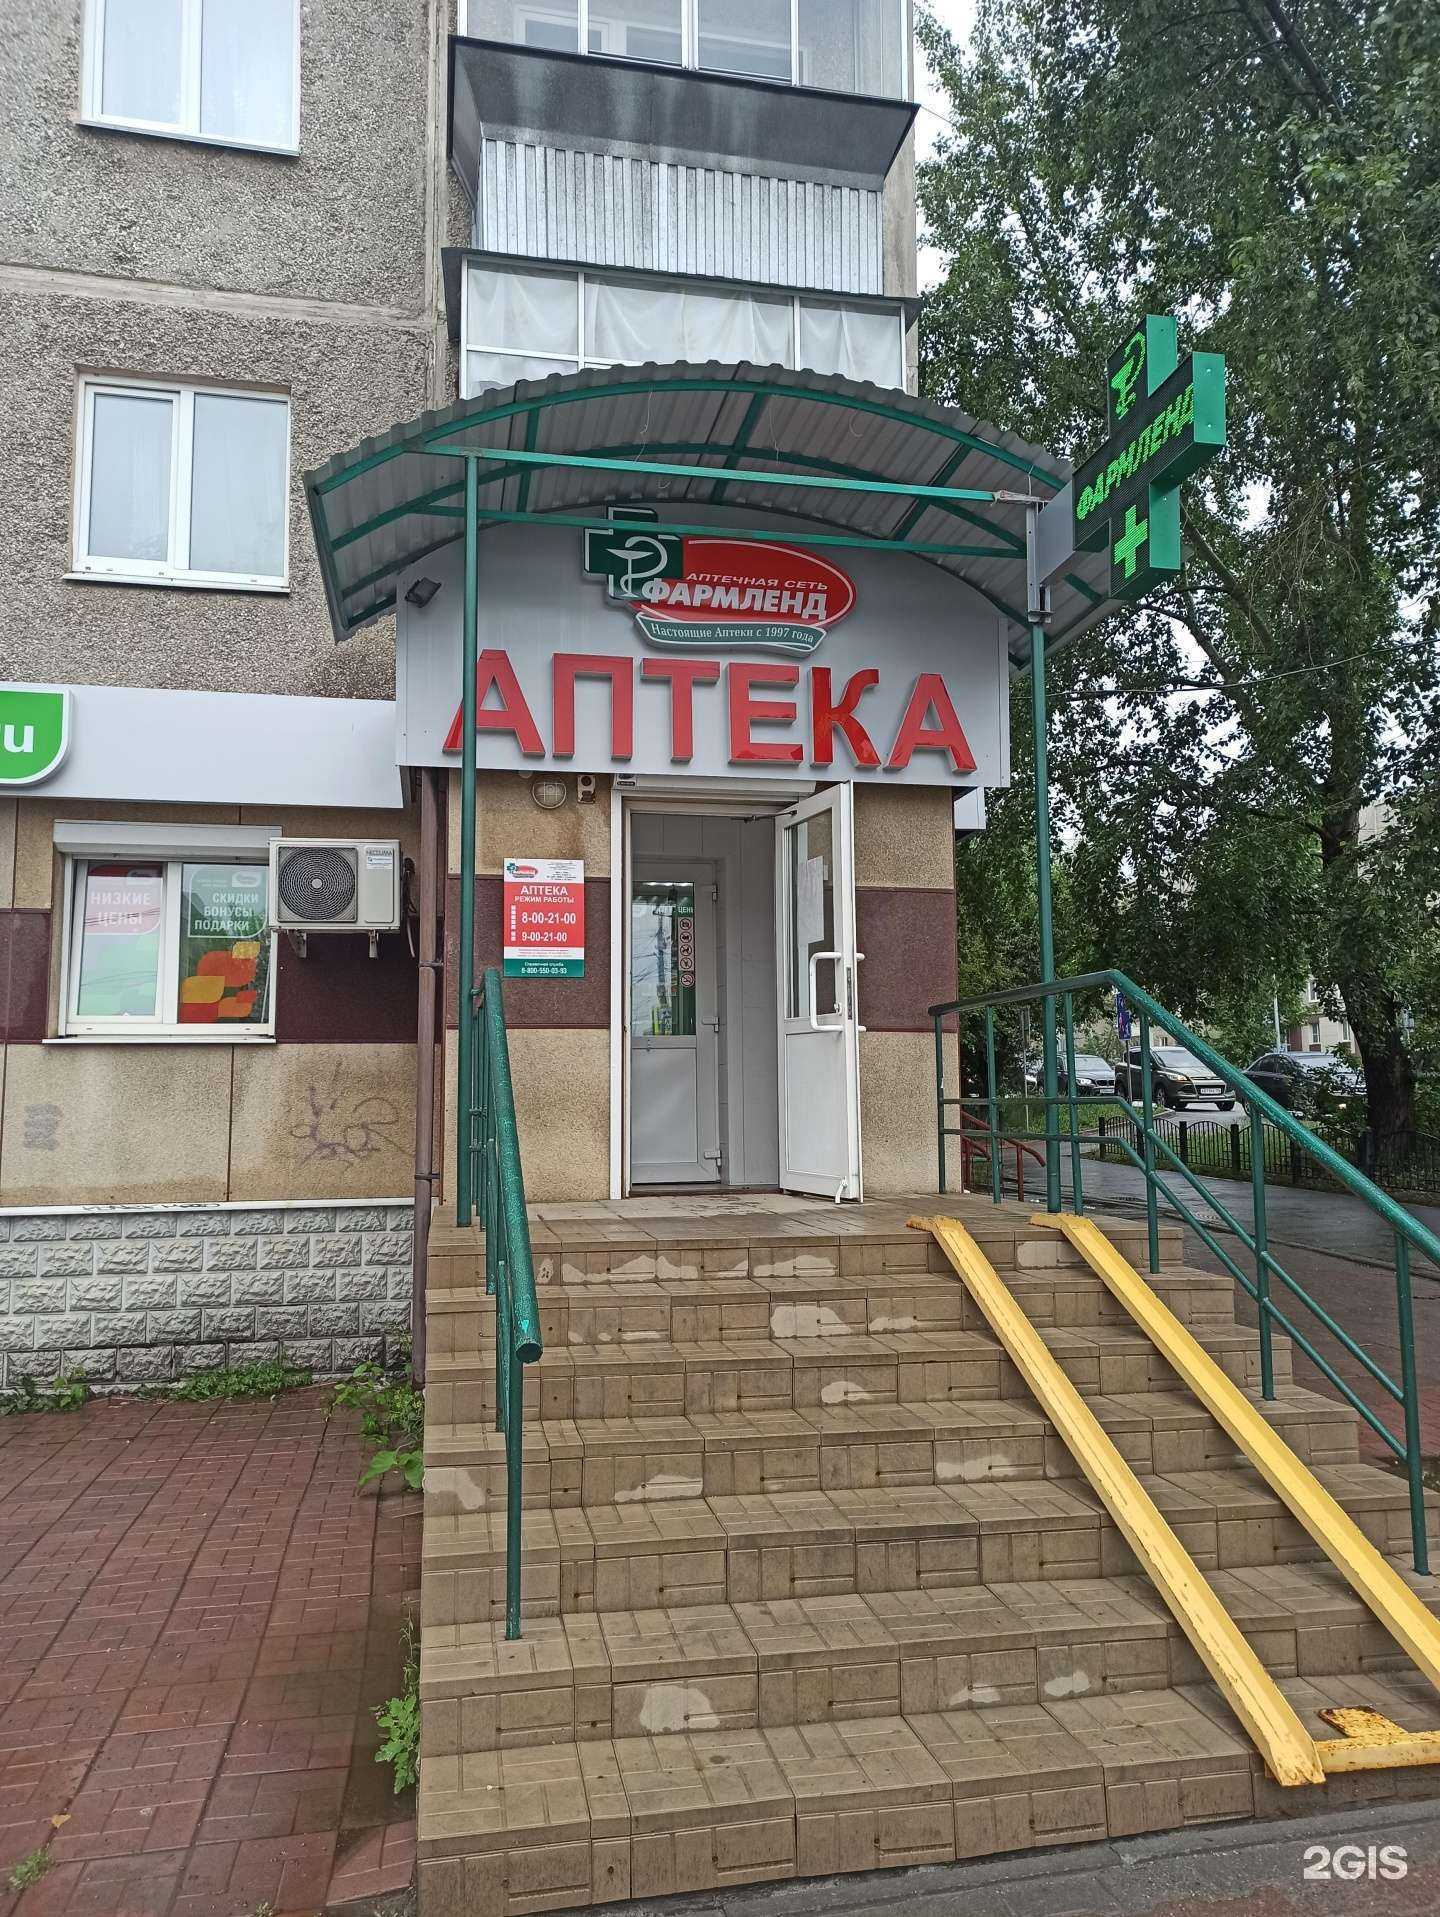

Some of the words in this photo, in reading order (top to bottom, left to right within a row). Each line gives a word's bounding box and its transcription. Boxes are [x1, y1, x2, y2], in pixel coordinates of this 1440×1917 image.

[686, 572, 778, 588] АПТЕЧНАЯ
[784, 580, 828, 591] СЕТЬ
[641, 578, 827, 620] ФАРМЛЕНД
[650, 622, 712, 639] Настоящие
[714, 626, 753, 638] Аптеки
[756, 629, 762, 638] с
[766, 626, 790, 639] 1997
[791, 630, 815, 643] года
[442, 648, 978, 774] АПТЕКА
[520, 885, 568, 896] АПТЕКА
[91, 891, 151, 906] НИЗКИЕ
[212, 892, 259, 905] СКИДКИ
[514, 895, 542, 903] РЕЖИМ
[543, 896, 575, 904] РАБОТЫ
[204, 906, 252, 918] БОНУСЫ
[521, 912, 577, 924] 8-00-21-00
[98, 911, 143, 927] ЦЕНЫ
[194, 919, 249, 931] ПОДАРКИ
[521, 932, 568, 942] 9-00-21-00
